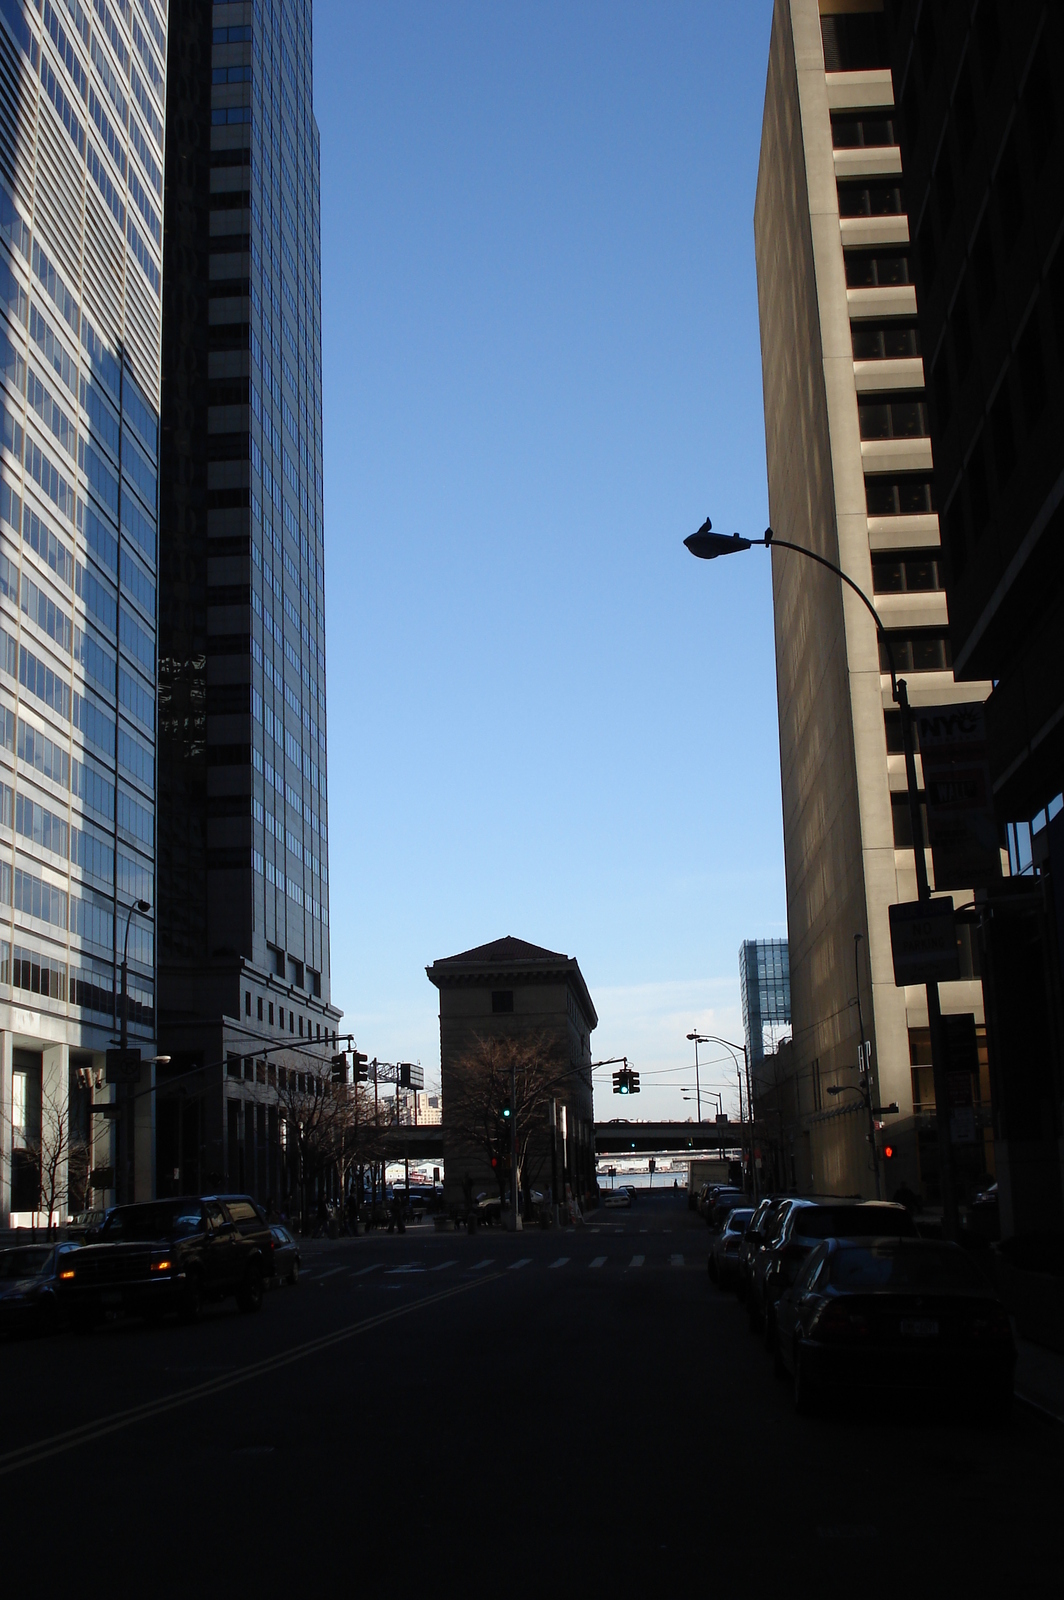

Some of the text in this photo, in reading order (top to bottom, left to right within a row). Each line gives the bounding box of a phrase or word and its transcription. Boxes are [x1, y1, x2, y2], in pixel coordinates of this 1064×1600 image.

[920, 709, 980, 738] NYC
[936, 782, 968, 802] WALL
[912, 921, 932, 936] NO
[903, 936, 945, 951] PARKING
